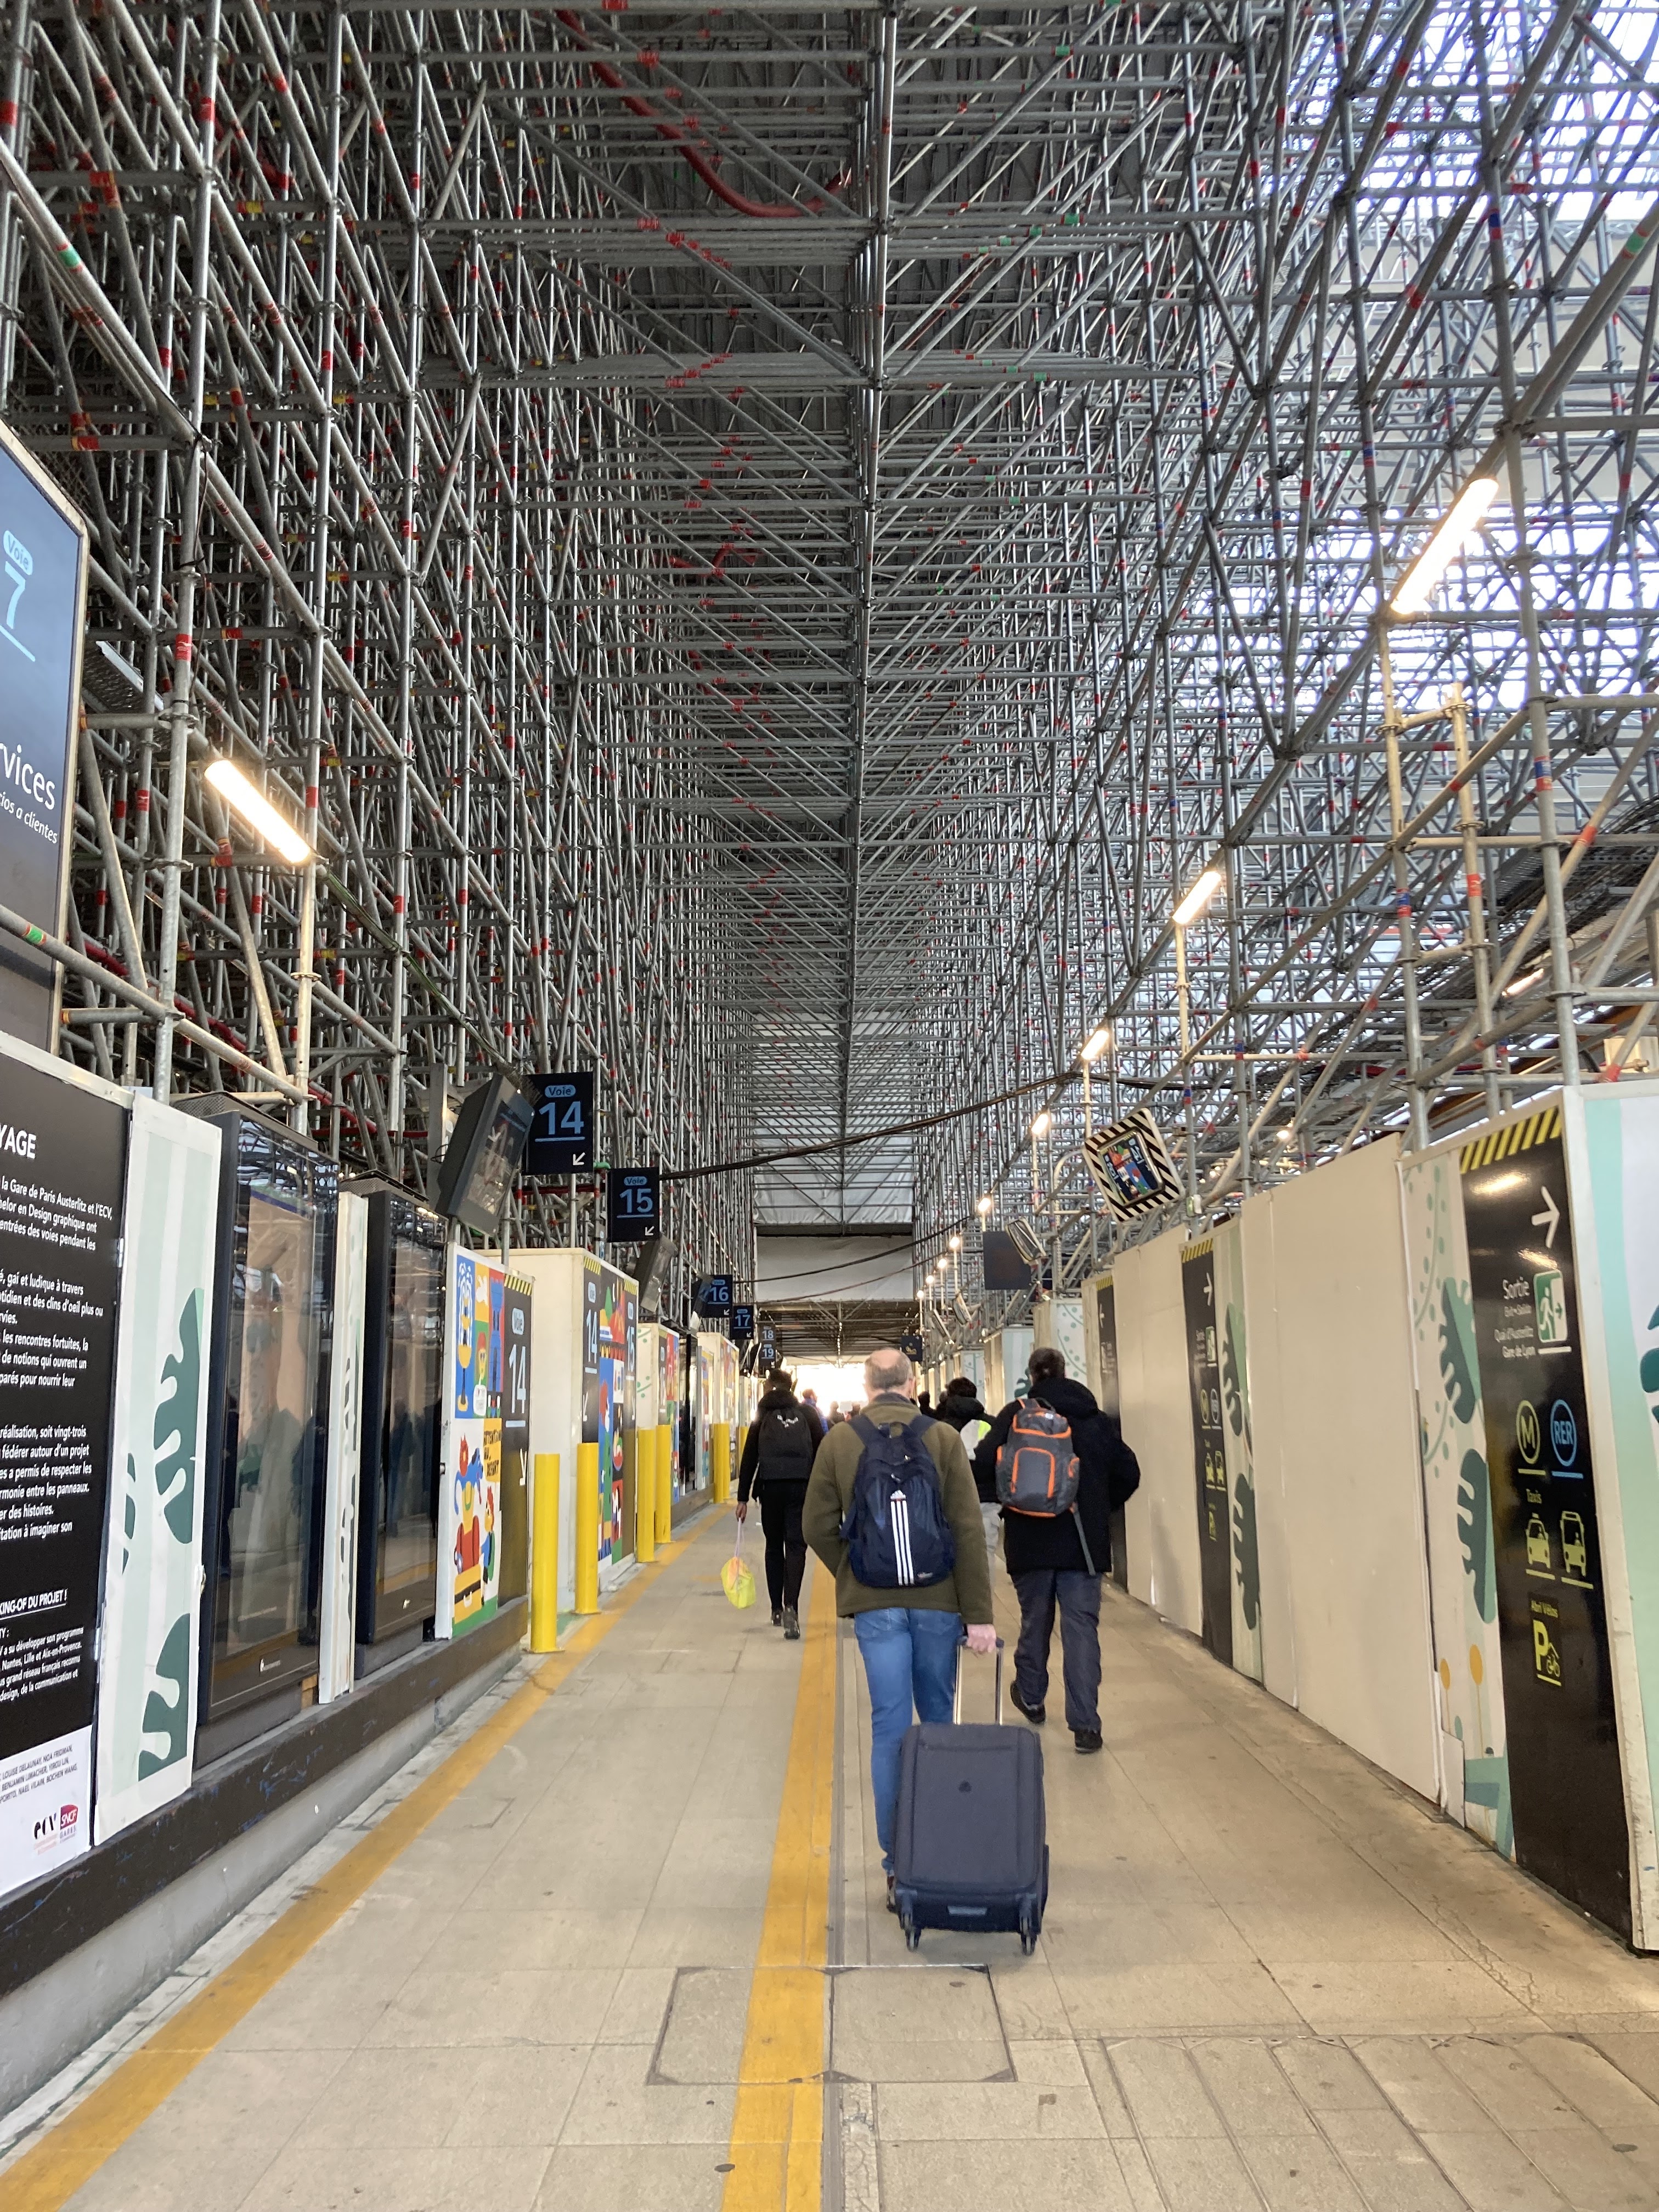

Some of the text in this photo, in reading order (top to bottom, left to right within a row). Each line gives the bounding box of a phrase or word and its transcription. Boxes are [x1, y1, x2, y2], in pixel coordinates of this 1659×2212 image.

[8, 535, 29, 570] Voie
[5, 561, 26, 629] 7
[16, 807, 23, 820] a
[24, 811, 57, 844] clientes
[549, 1087, 571, 1096] Voie
[539, 1101, 584, 1135] 14
[2, 1176, 8, 1190] la
[10, 1179, 27, 1195] Gare
[29, 1183, 38, 1198] de
[40, 1187, 55, 1204] Paris
[57, 1192, 87, 1212] Austerlitz
[87, 1204, 94, 1215] et
[620, 1188, 653, 1214] 15
[18, 1204, 27, 1215] en
[29, 1204, 52, 1224] Design
[53, 1213, 85, 1231] graphique
[86, 1221, 97, 1233] ont
[0, 1218, 96, 1251] entrées des voies pendant les
[7, 1272, 19, 1287] gai
[20, 1274, 28, 1286] et
[30, 1273, 55, 1293] ludique
[56, 1279, 60, 1291] à
[62, 1281, 83, 1295] travers
[709, 1286, 729, 1302] 16
[1503, 1276, 1530, 1300] Sortie
[0, 1290, 103, 1317] tidien et des clins d'oeil plus ou
[735, 1314, 751, 1327] 17
[3, 1329, 88, 1352] les rencontres fortuites, la
[586, 1309, 597, 1364] 14
[762, 1330, 774, 1339] 18
[2, 1349, 87, 1370] de notions qui ouvrent un
[627, 1325, 635, 1372] 15
[762, 1348, 774, 1358] 19
[20, 1374, 37, 1388] pour
[38, 1373, 61, 1386] nourrir
[62, 1373, 75, 1387] leur
[509, 1344, 527, 1414] 14
[0, 1425, 86, 1441] réalisation, soit vingt-trois
[1521, 1415, 1536, 1449] M
[1554, 1421, 1574, 1445] RER
[2, 1443, 89, 1459] fédérer autour d'un projet
[9, 1468, 14, 1479] a
[15, 1463, 40, 1482] permis
[41, 1463, 50, 1477] de
[51, 1464, 82, 1479] respecter
[83, 1460, 92, 1474] les
[26, 1485, 44, 1497] entre
[46, 1482, 55, 1496] les
[57, 1483, 89, 1498] panneaux.
[9, 1504, 21, 1519] des
[23, 1502, 54, 1517] histoires.
[24, 1523, 29, 1537] à
[30, 1522, 60, 1539] imaginer
[61, 1521, 72, 1532] son
[28, 1596, 38, 1609] DU
[40, 1589, 64, 1606] PROJET
[64, 1588, 68, 1601] !
[4, 1647, 8, 1655] a
[8, 1645, 15, 1654] su
[16, 1637, 46, 1652] développer
[46, 1634, 55, 1644] son
[1533, 1620, 1549, 1672] P
[2, 1658, 22, 1671] Nantes,
[24, 1652, 35, 1664] Lille
[36, 1651, 41, 1661] et
[6, 1669, 22, 1688] grand
[23, 1668, 41, 1680] réseau
[42, 1660, 60, 1673] français
[21, 1683, 27, 1695] de
[29, 1681, 33, 1692] la
[35, 1671, 72, 1690] communication
[72, 1668, 78, 1678] et
[61, 1809, 77, 1827] SNCF
